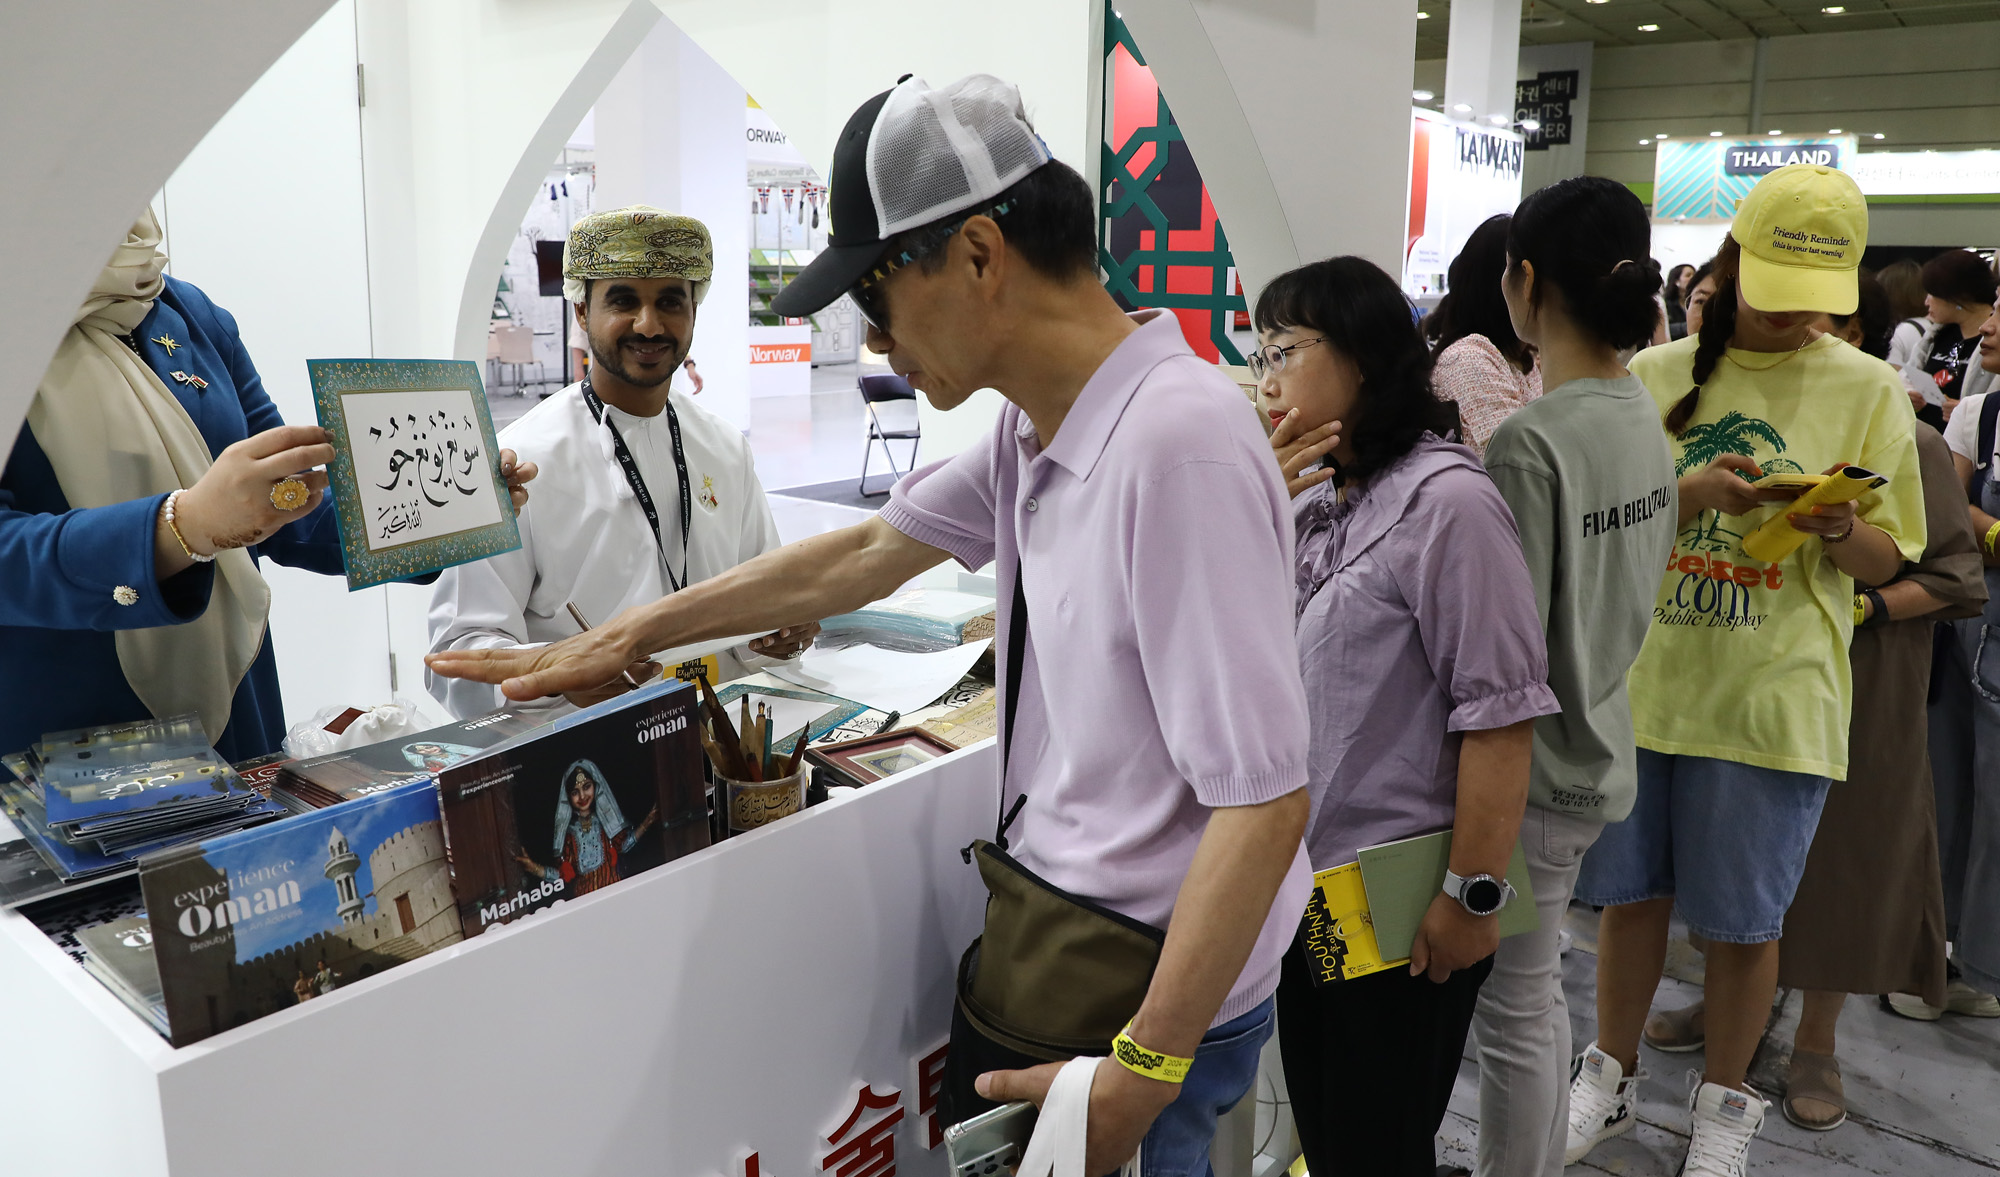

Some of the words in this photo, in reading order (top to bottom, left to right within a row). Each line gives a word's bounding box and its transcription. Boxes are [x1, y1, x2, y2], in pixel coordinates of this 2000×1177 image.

[1732, 150, 1832, 168] THAILAND
[1773, 226, 1809, 244] Friendly
[1810, 233, 1850, 246] Reminder
[1792, 245, 1808, 253] your
[750, 347, 801, 363] Norway
[1583, 507, 1620, 538] FILA
[1652, 607, 1703, 626] Public
[1706, 609, 1768, 632] Display
[677, 667, 706, 678] EXHIBITOR
[635, 705, 686, 728] experience
[637, 715, 687, 744] oman
[461, 773, 514, 795] #experienceoman
[174, 859, 295, 908] experience
[178, 880, 302, 937] oman
[481, 878, 565, 926] Marhaba
[190, 934, 226, 952] Beauty
